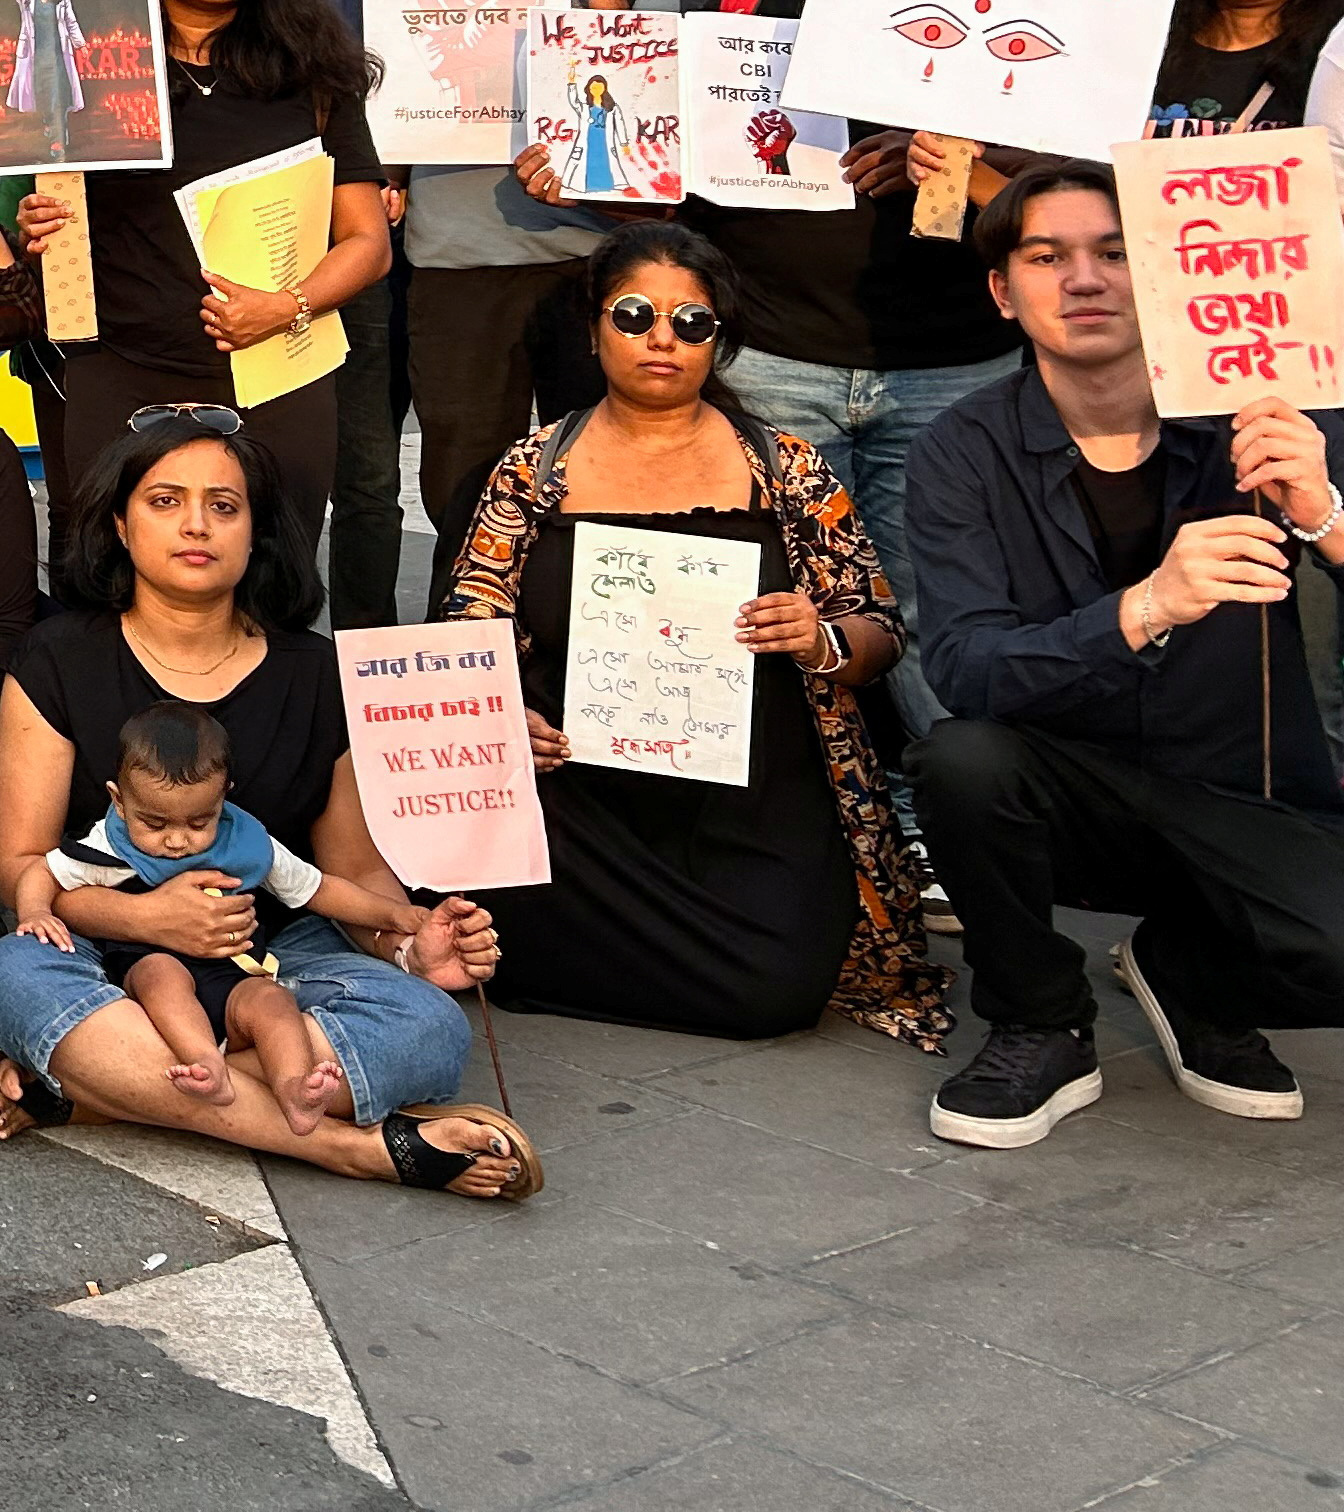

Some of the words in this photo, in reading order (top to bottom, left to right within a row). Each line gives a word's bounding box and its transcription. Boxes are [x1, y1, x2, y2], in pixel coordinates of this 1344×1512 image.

[402, 8, 466, 36] ভুলতে
[475, 8, 510, 26] দেব
[541, 13, 578, 47] We
[75, 46, 140, 76] KAR
[582, 37, 679, 67] JUSTICE
[718, 36, 753, 57] আর
[740, 63, 772, 78] CBI
[709, 83, 773, 105] পারতেই
[636, 115, 680, 144] KAR
[709, 174, 829, 192] #justiceForAbhaya
[382, 746, 426, 773] WE
[430, 742, 507, 769] WANT
[392, 788, 516, 819] JUSTICE!!
